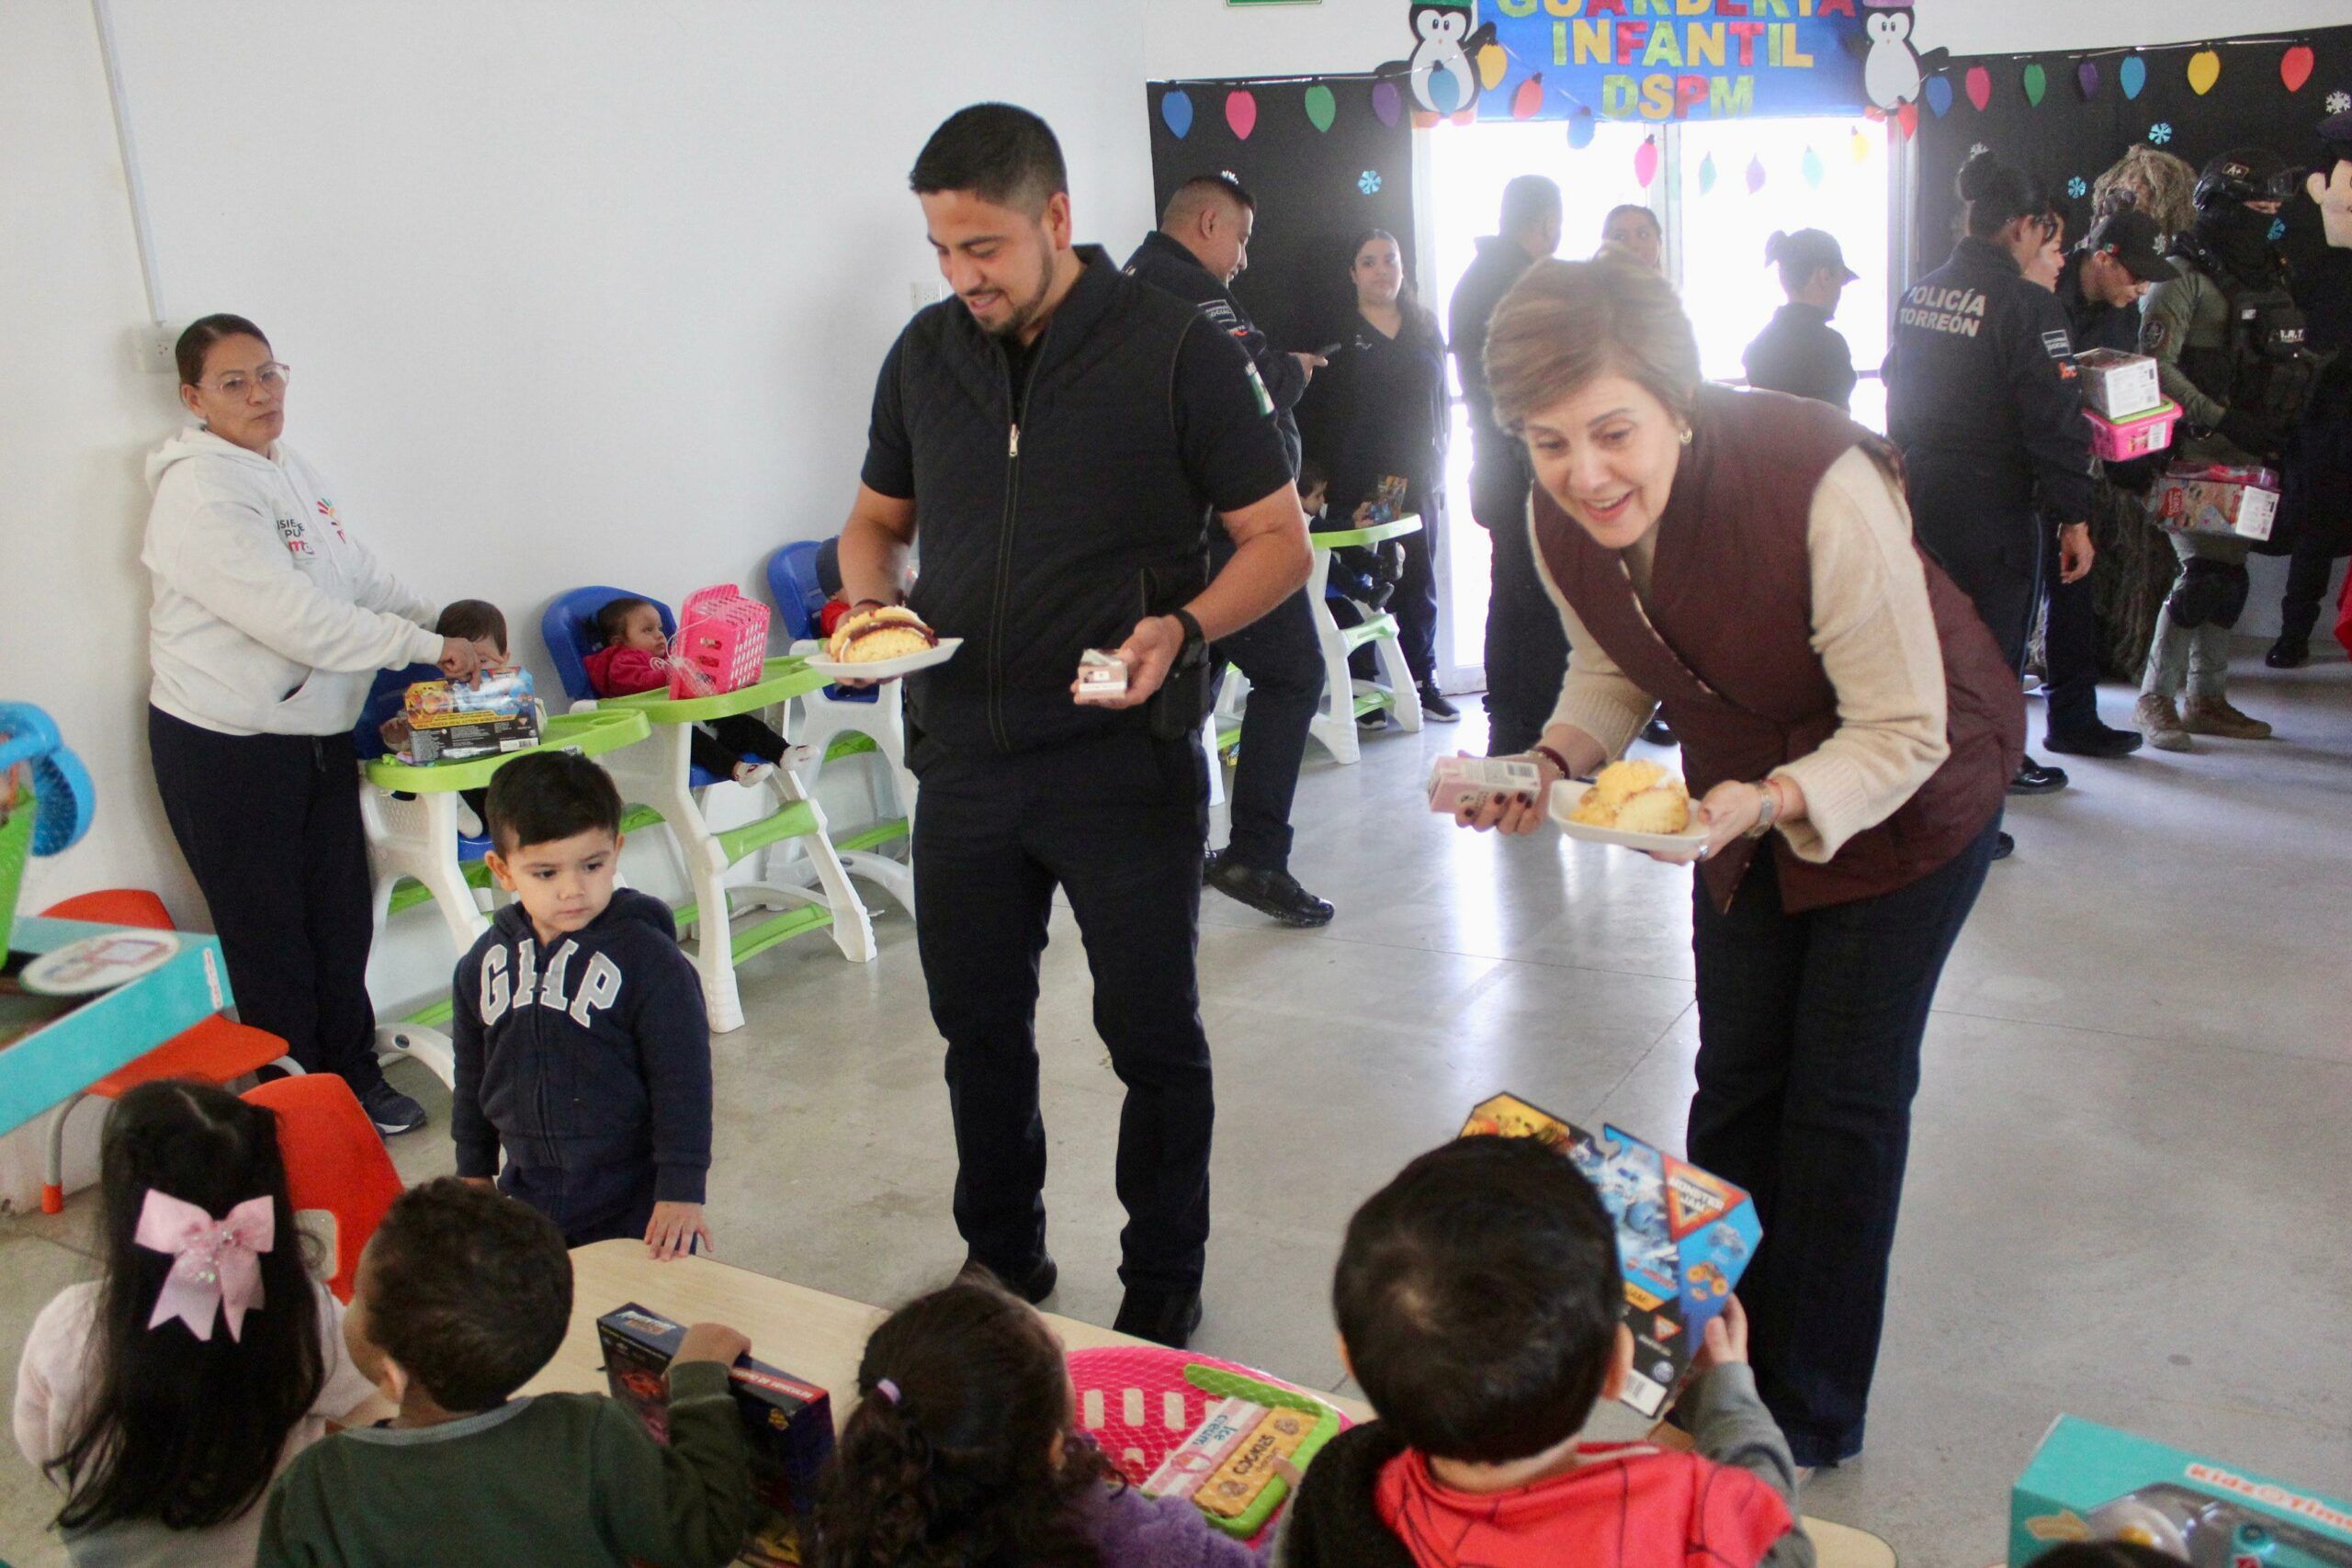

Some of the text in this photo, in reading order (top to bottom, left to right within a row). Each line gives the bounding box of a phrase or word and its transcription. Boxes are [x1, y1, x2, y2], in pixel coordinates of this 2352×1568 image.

[1553, 19, 1814, 67] INFANTIL
[1602, 74, 1755, 119] DSPM
[1900, 307, 1980, 337] TORREÓN
[481, 938, 622, 1028] GAP
